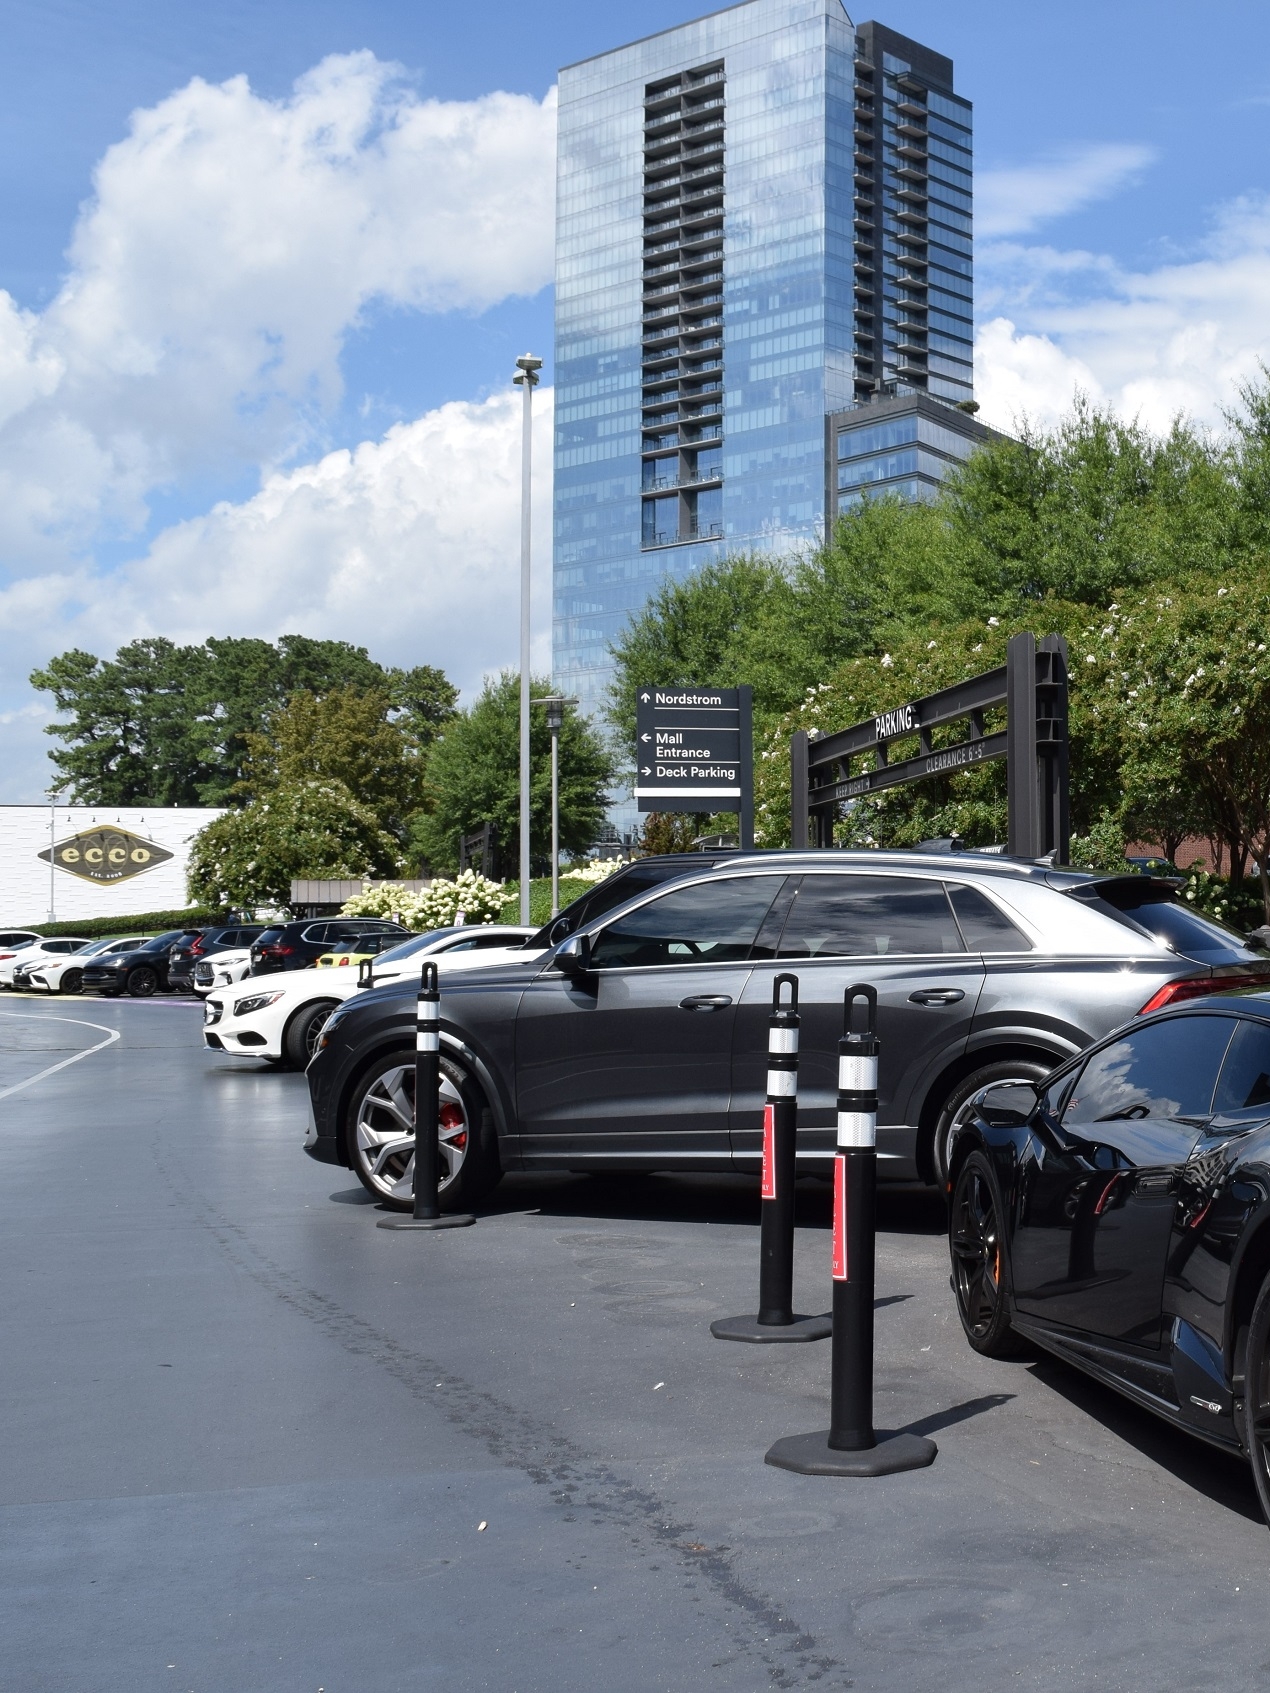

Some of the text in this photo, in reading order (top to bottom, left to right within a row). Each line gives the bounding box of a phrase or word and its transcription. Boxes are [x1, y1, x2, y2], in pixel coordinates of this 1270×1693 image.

[655, 693, 721, 705] Nordstrom
[875, 705, 912, 740] PARKING
[656, 733, 683, 744] Mall
[656, 747, 711, 758] Entrance
[926, 747, 966, 773] CLEARANCE
[656, 766, 736, 780] Deck Parking
[61, 848, 151, 863] ecco
